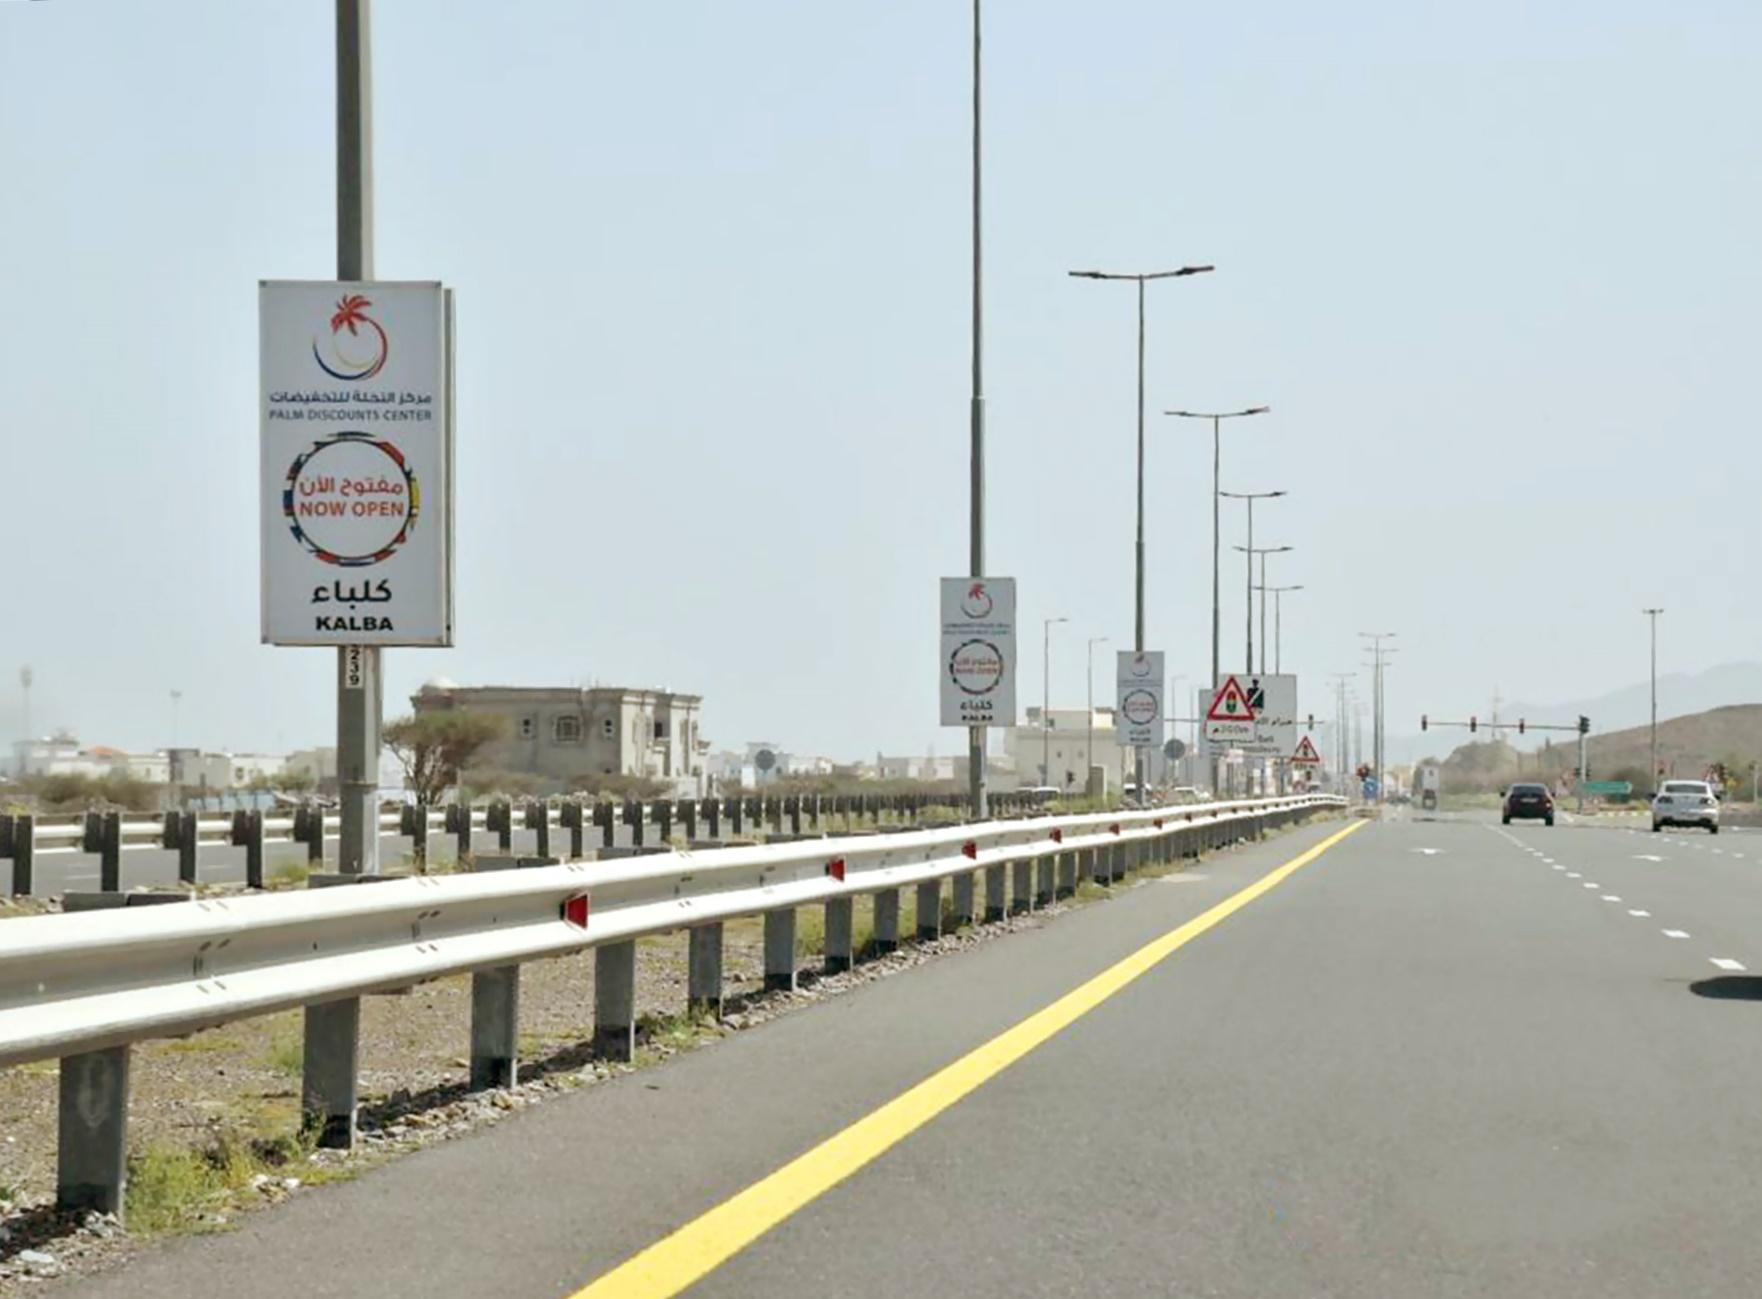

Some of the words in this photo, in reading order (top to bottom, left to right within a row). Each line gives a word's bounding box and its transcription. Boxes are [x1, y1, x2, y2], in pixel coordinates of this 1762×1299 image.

[269, 409, 304, 421] PALM
[307, 409, 379, 421] DISCOUNTS
[382, 409, 432, 421] CENTER
[340, 474, 403, 497] مفتوح
[299, 501, 346, 517] NOW
[352, 501, 404, 517] OPEN
[310, 579, 393, 610] كلباء
[315, 616, 394, 632] KALBA
